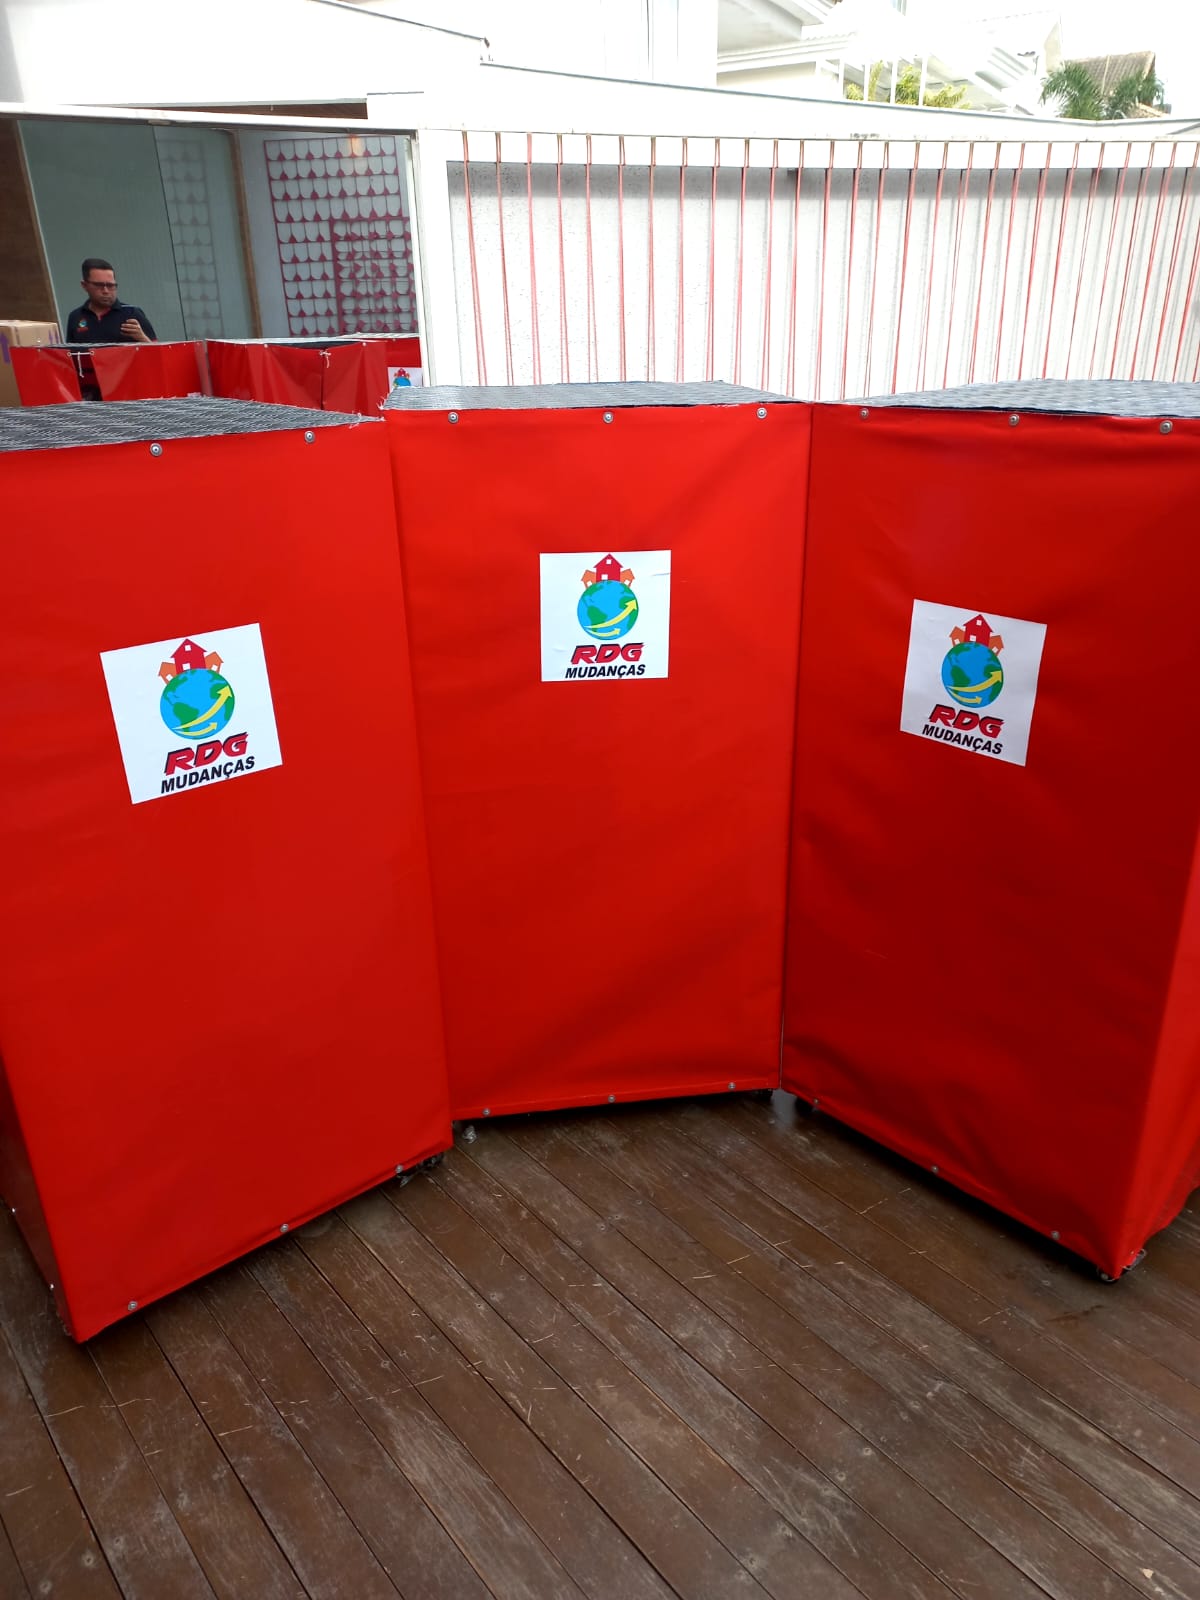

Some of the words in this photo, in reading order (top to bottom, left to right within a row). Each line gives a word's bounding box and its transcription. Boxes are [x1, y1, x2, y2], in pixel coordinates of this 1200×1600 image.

[570, 642, 645, 665] RDG
[565, 664, 646, 678] MUDANÇAS
[928, 704, 1005, 738] RDG
[164, 732, 248, 776] RDG
[922, 724, 1003, 754] MUDANÇAS
[161, 756, 255, 794] MUDANÇAS
